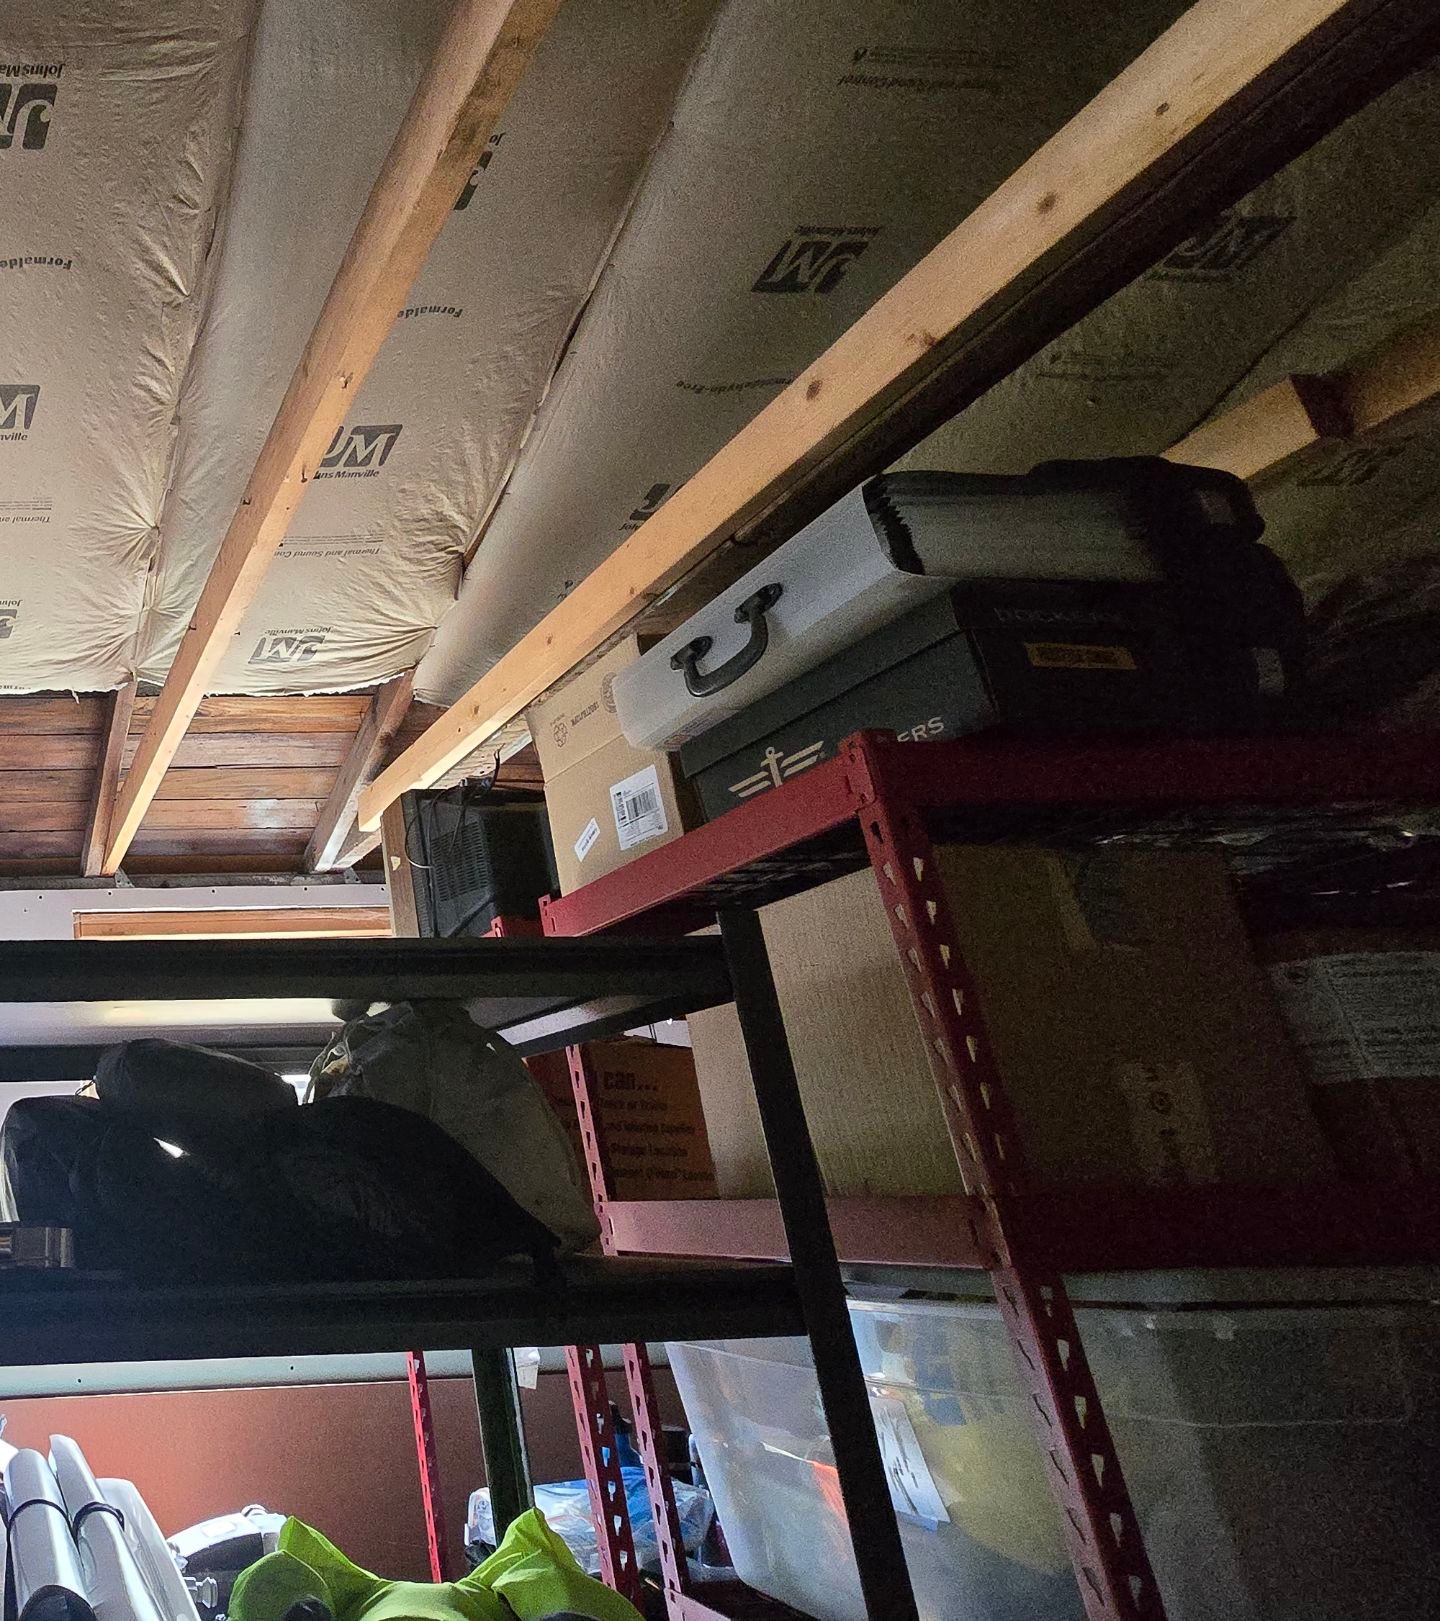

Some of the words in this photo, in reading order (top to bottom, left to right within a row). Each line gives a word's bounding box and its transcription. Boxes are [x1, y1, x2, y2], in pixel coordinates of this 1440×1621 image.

[18, 62, 67, 79] Johns
[750, 240, 868, 294] JM
[396, 305, 463, 320] Formalde
[320, 423, 403, 468] JM
[334, 469, 380, 479] Manville
[11, 516, 51, 525] Thermal
[273, 550, 292, 559] Con
[293, 550, 324, 559] Sound
[324, 549, 343, 558] and
[343, 547, 381, 558] Thermal
[264, 628, 305, 637] Manville
[305, 626, 334, 635] Johns
[247, 635, 326, 665] JM
